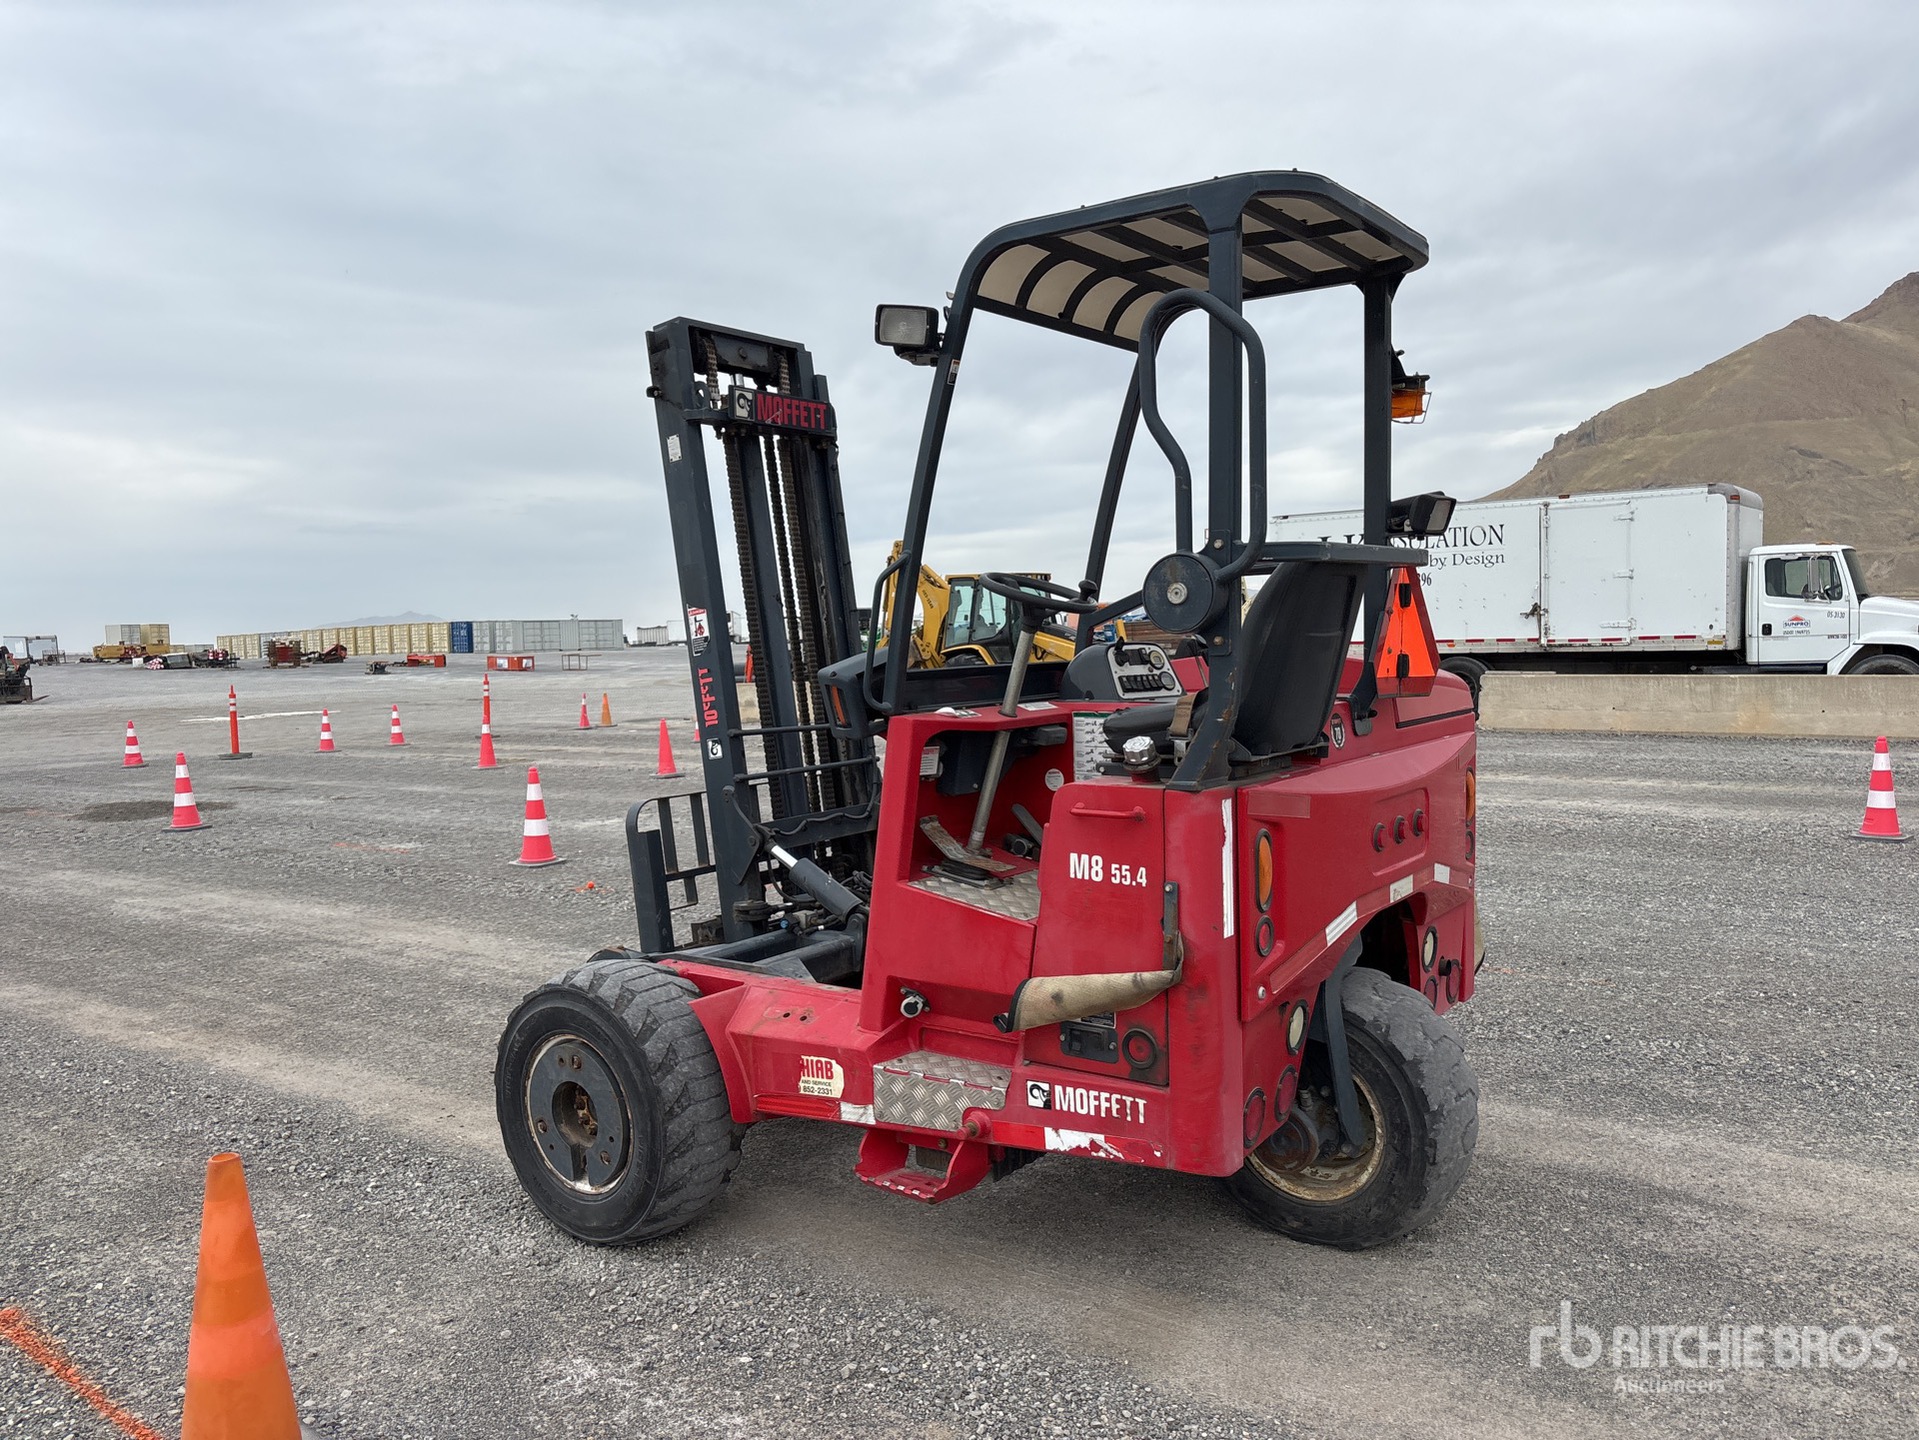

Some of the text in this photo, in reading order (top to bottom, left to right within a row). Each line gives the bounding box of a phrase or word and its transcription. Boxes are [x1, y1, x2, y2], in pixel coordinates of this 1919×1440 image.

[757, 393, 827, 430] MOFFETT
[1429, 551, 1505, 570] by Design
[1070, 852, 1147, 887] M8 55.4
[801, 1058, 834, 1080] HIAB
[1054, 1084, 1148, 1124] MOFFETT
